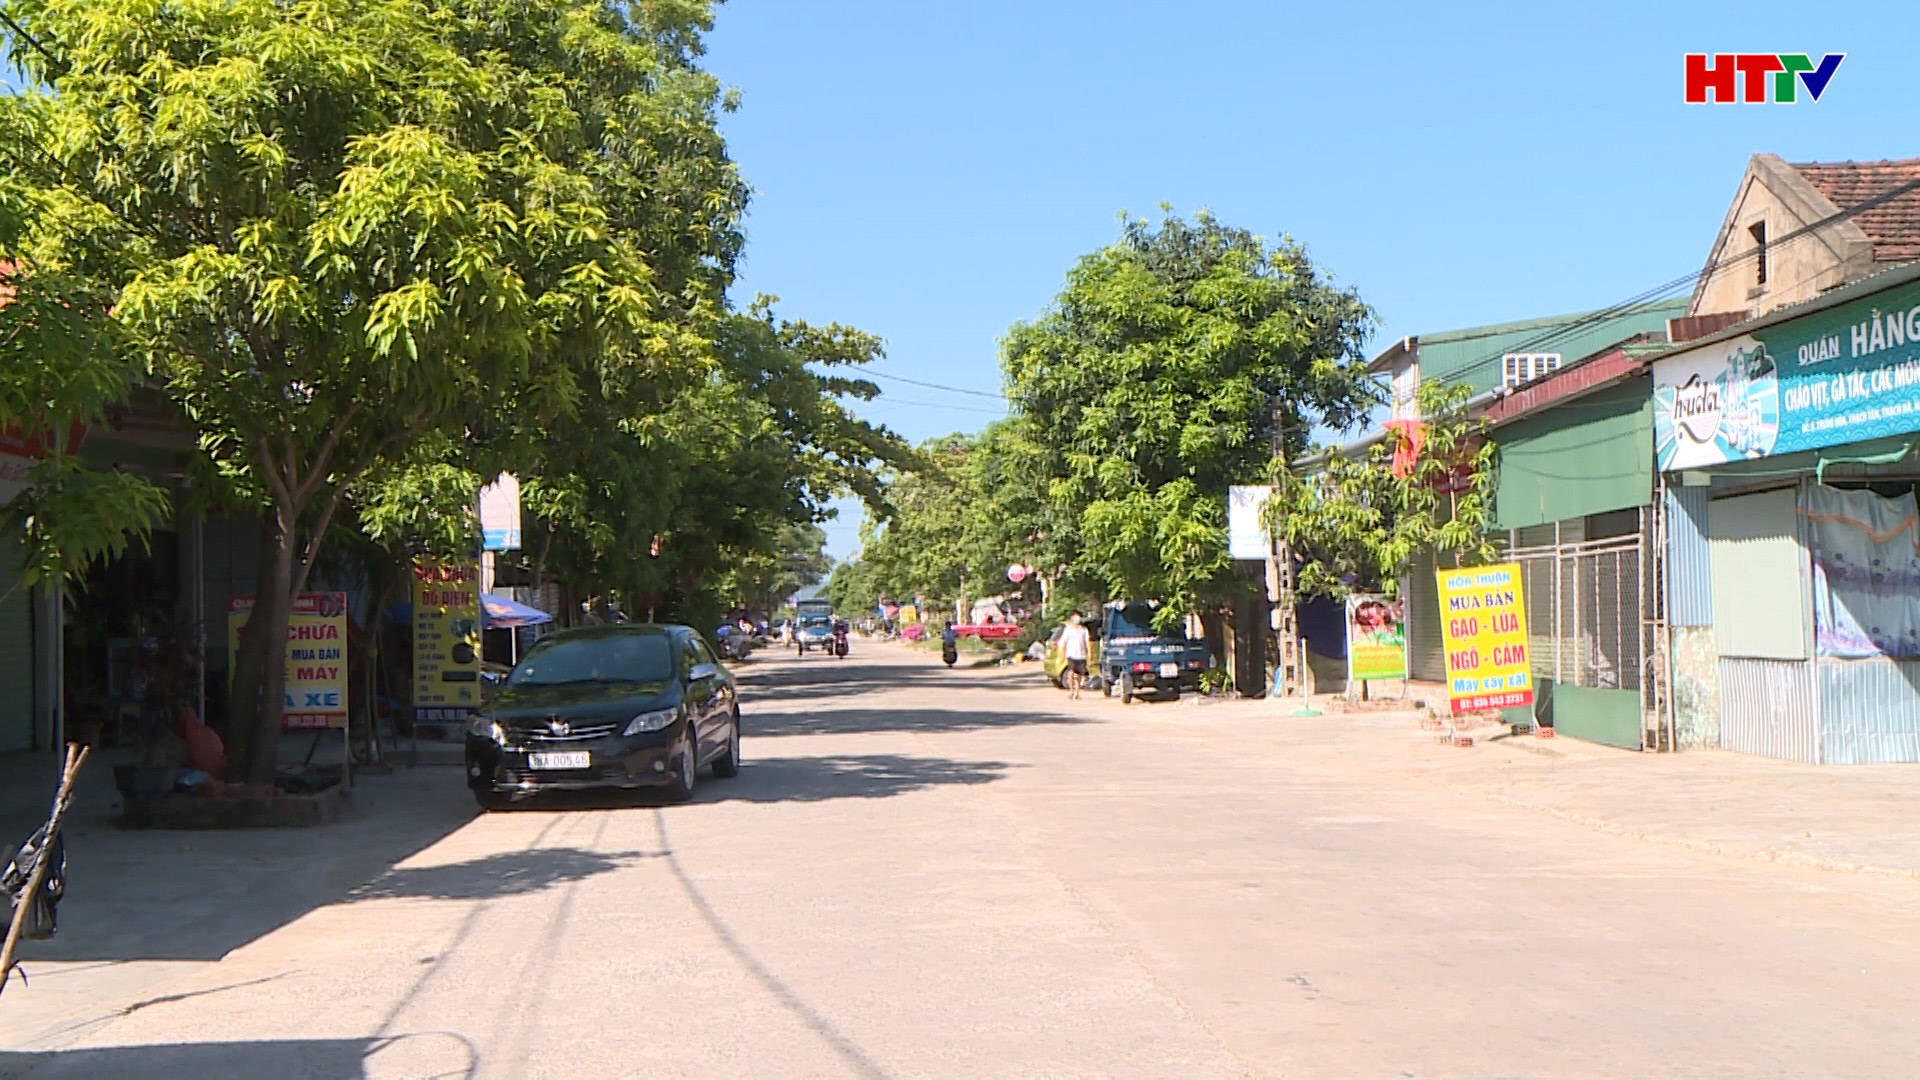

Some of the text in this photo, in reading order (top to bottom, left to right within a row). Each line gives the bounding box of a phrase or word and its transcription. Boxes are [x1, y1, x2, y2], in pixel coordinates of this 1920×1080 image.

[1798, 335, 1841, 366] QUÁN
[1831, 372, 1846, 402] GÀ
[1871, 363, 1893, 394] CÁC
[1449, 590, 1514, 611] MUA BÁN
[1450, 616, 1478, 642] GẠO
[1492, 610, 1519, 634] LÚA
[291, 649, 315, 660] MUA
[1450, 646, 1479, 671] NGÔ
[305, 693, 339, 707] XE
